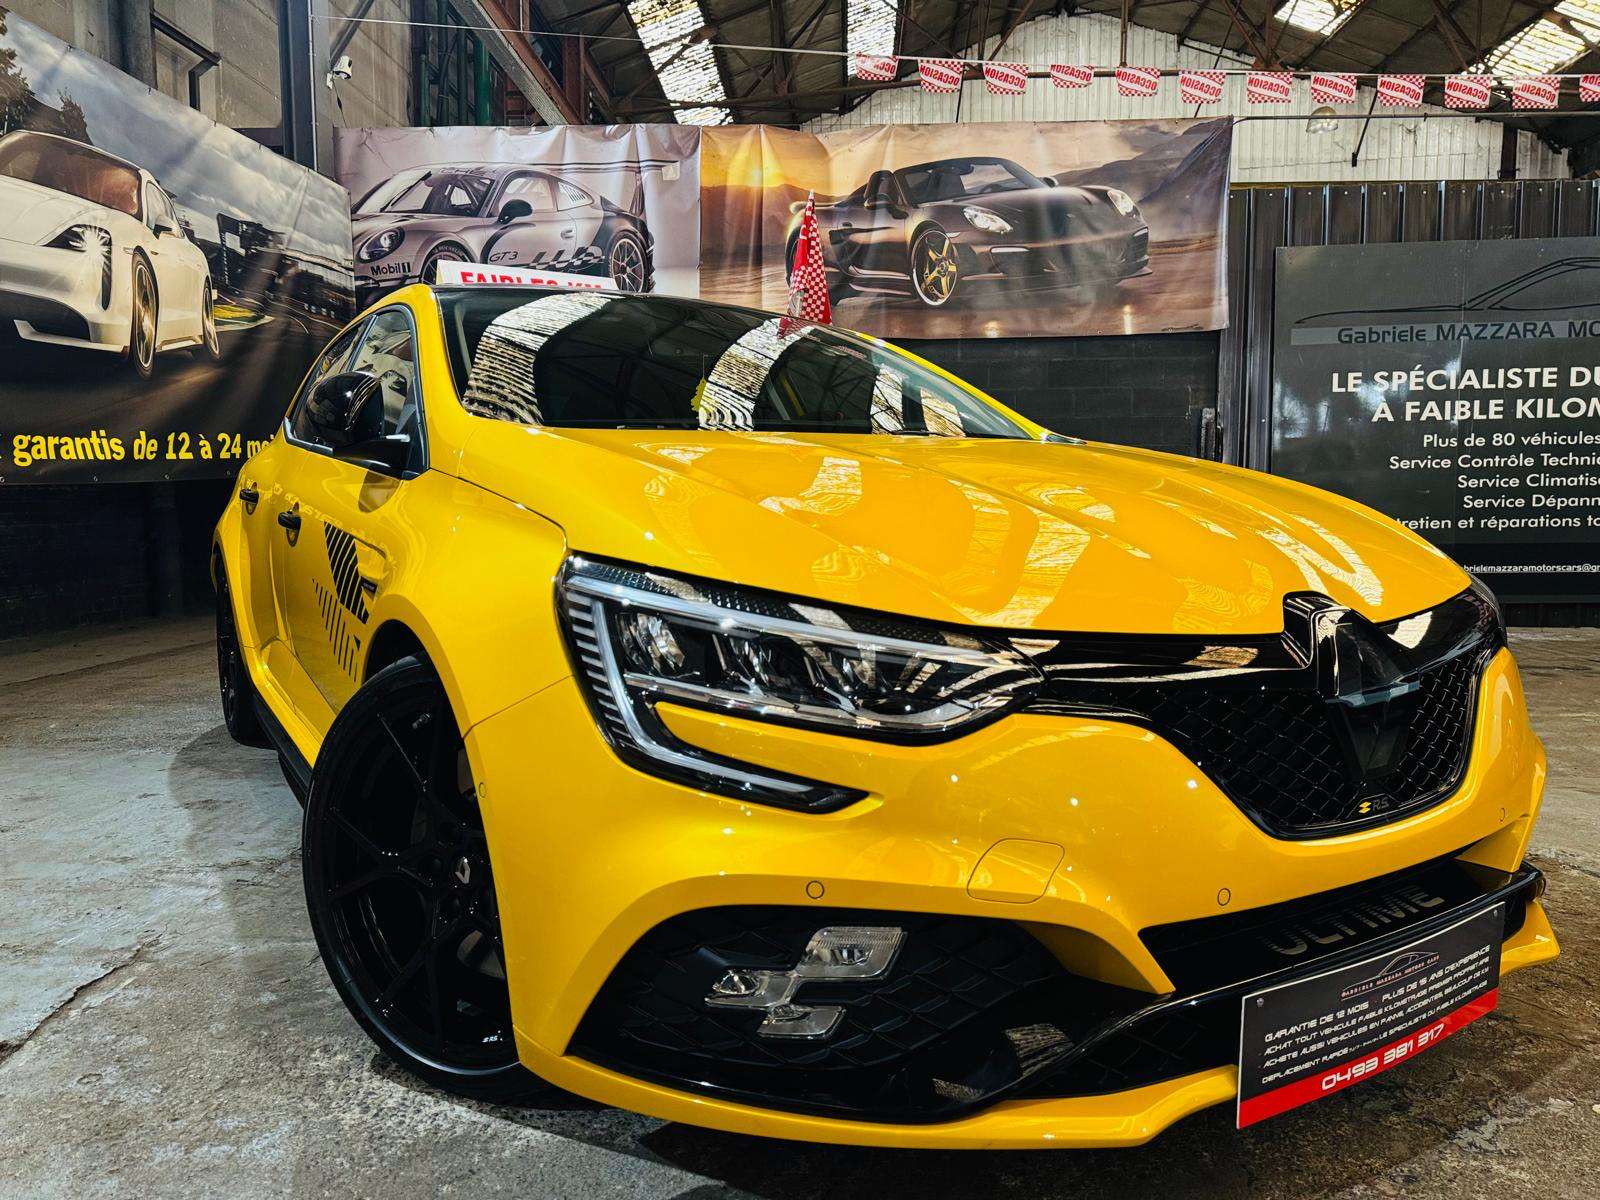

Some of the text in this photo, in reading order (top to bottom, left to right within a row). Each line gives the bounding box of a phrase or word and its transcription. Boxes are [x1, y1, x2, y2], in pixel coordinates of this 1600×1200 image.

[489, 250, 518, 262] GT3
[370, 262, 401, 275] Mobil
[1337, 325, 1426, 344] Gabriele
[1436, 321, 1555, 341] MAZZARA
[1332, 371, 1362, 392] LE
[1373, 364, 1558, 391] SPÉCIALISTE
[1405, 399, 1504, 421] FAIBLE
[13, 430, 126, 467] garantis
[133, 430, 158, 460] de
[165, 431, 194, 460] 12
[199, 433, 213, 459] à
[217, 432, 242, 459] 24
[1423, 430, 1600, 448] Plus de 80 véhicules
[1389, 455, 1452, 469] Service
[1457, 452, 1535, 468] Contrôle
[1457, 474, 1520, 488] Service
[1463, 494, 1600, 510] Service Dépann
[1396, 516, 1452, 529] tretien
[1457, 516, 1475, 529] et
[1480, 514, 1581, 532] réparations
[1463, 563, 1600, 573] brielemazzaramotorscars@g
[1264, 1019, 1318, 1042] GARANTIE
[1320, 1013, 1334, 1025] DE
[1336, 1009, 1346, 1019] 12
[1347, 1001, 1370, 1015] MOIS
[1381, 988, 1405, 1002] PLUS
[1406, 981, 1418, 992] DE
[1429, 969, 1444, 982] ANS
[1264, 1040, 1293, 1056] ACHAT
[1295, 1031, 1319, 1044] TOUT
[1320, 1018, 1357, 1036] VEHICULE
[1358, 1008, 1383, 1022] FAIBLE
[1383, 989, 1428, 1012] KILOMETRAGE
[1263, 1051, 1298, 1069] ACHETE
[1300, 1041, 1325, 1056] AUSSI
[1326, 1025, 1368, 1045] VEHICULES
[1369, 1020, 1380, 1030] EN
[1261, 1058, 1320, 1084] DEPLACEMENT
[1321, 1047, 1349, 1063] RAPIDE
[1321, 1056, 1379, 1091] 0493
[1383, 1039, 1414, 1065] 381
[1417, 1022, 1445, 1048] 317
